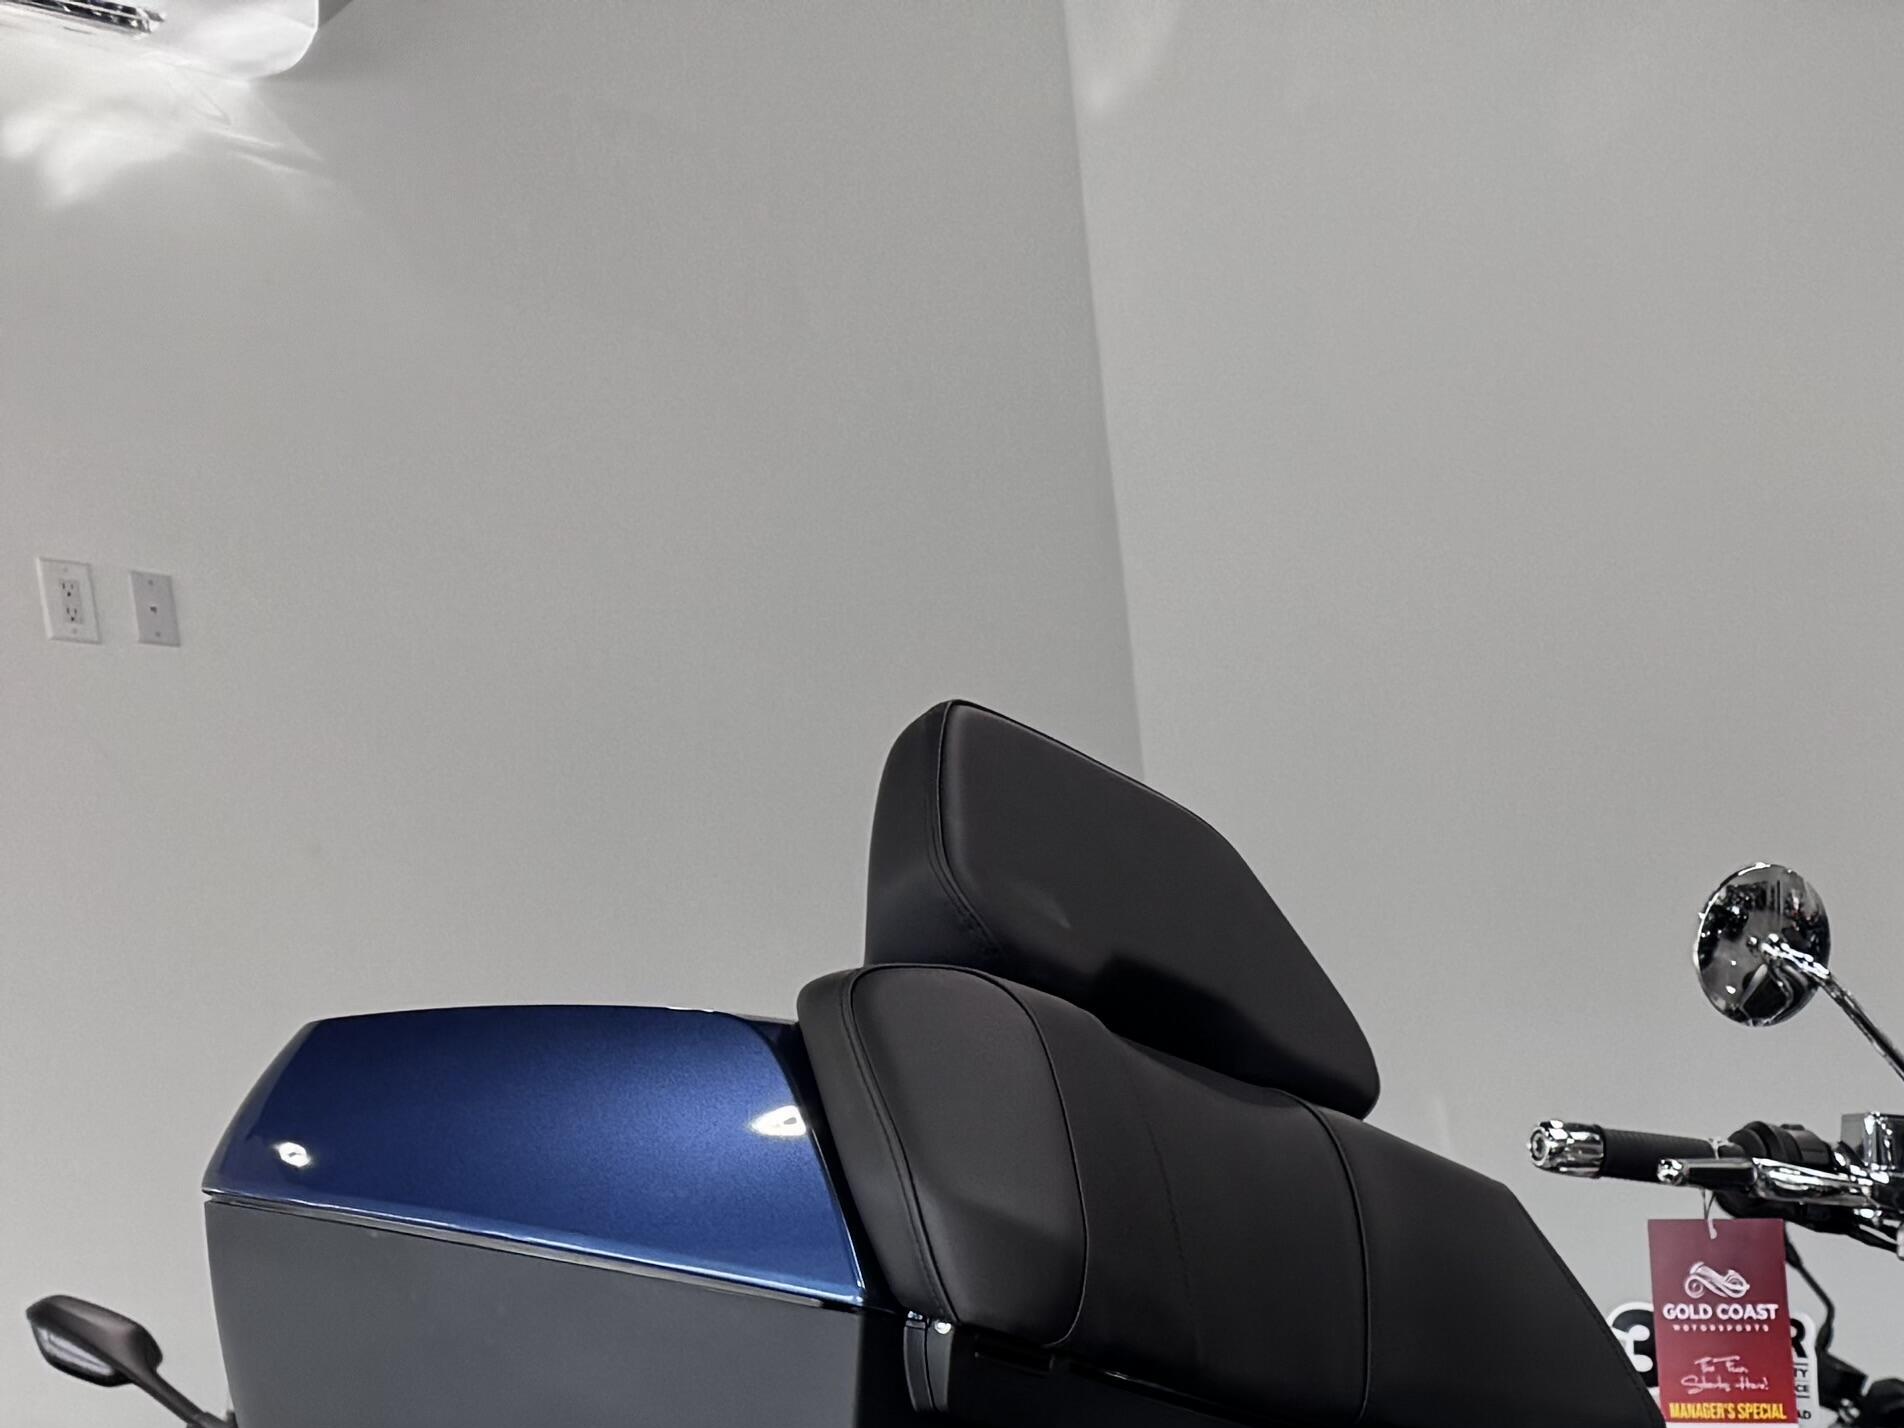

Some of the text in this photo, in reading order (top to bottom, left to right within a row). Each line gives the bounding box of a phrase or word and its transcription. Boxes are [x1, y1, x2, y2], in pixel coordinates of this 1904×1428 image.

[1662, 1303, 1779, 1320] GOLD COAST
[1668, 1402, 1736, 1420] MANAGER'S
[1737, 1403, 1788, 1420] SPECIAL
